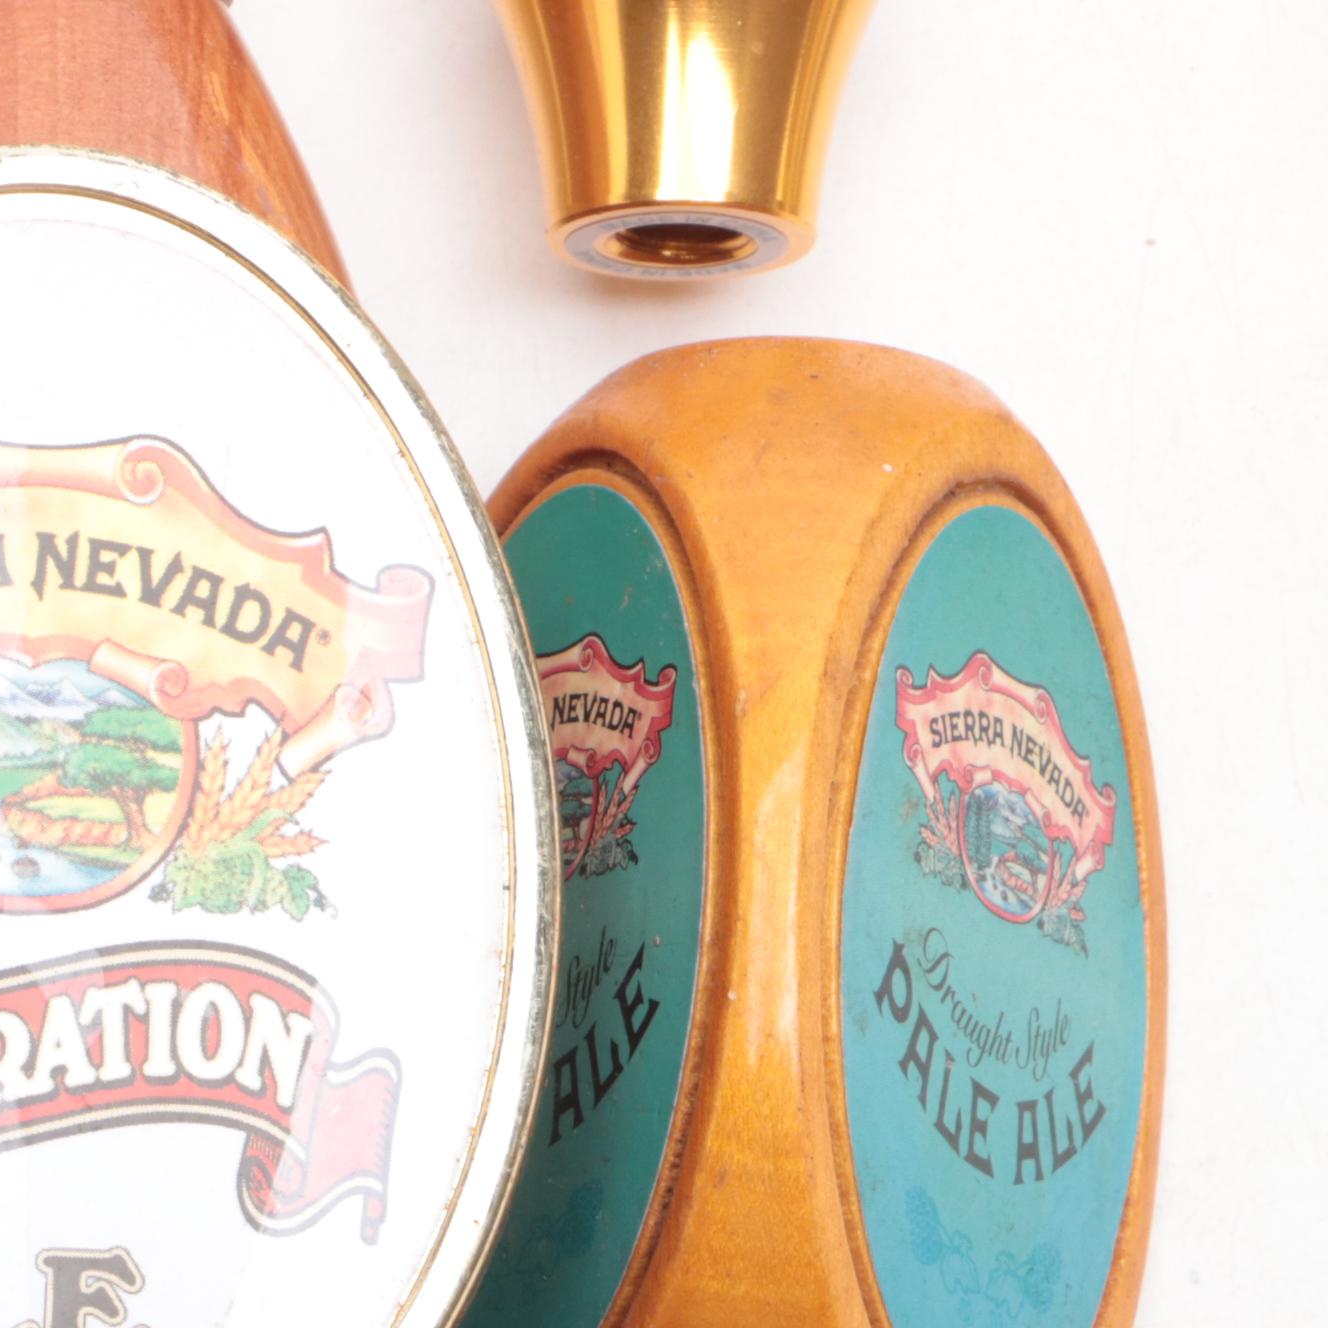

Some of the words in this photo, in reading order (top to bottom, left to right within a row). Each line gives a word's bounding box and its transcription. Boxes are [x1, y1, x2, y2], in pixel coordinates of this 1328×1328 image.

[929, 710, 1005, 749] SIERRA
[549, 942, 660, 1146] ALE
[555, 925, 617, 1029] Style
[917, 926, 1013, 1068] Draught
[1015, 998, 1070, 1082] Style
[873, 937, 1001, 1179] PALE
[1013, 1041, 1107, 1186] ALE
